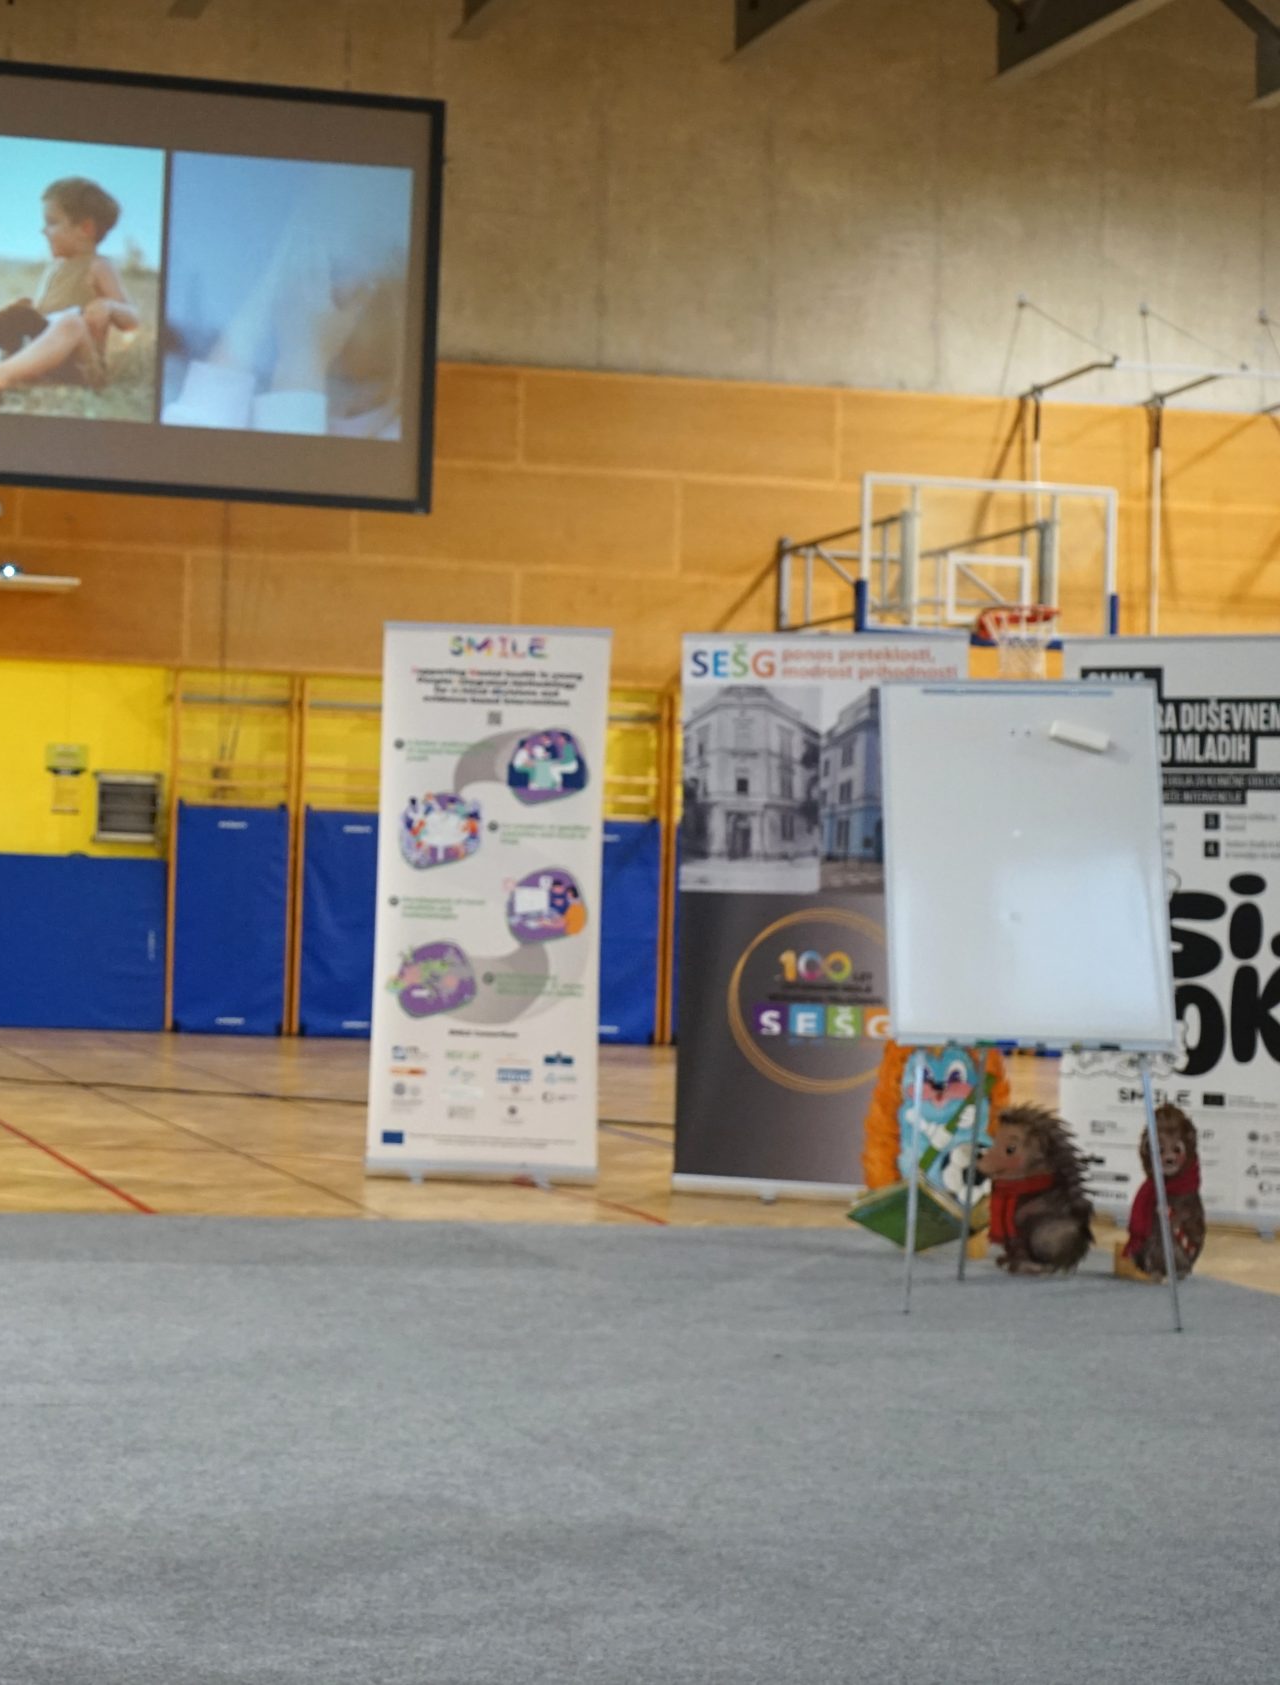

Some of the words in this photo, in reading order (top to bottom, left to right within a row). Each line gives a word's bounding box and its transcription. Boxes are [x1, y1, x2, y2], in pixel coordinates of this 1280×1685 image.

[448, 635, 549, 659] SMILE
[691, 642, 776, 678] SEŠG
[781, 649, 833, 662] ponos
[781, 665, 852, 680] modrost
[1175, 733, 1251, 763] MLADIH
[779, 949, 852, 983] 100
[759, 1004, 889, 1039] SEŠG
